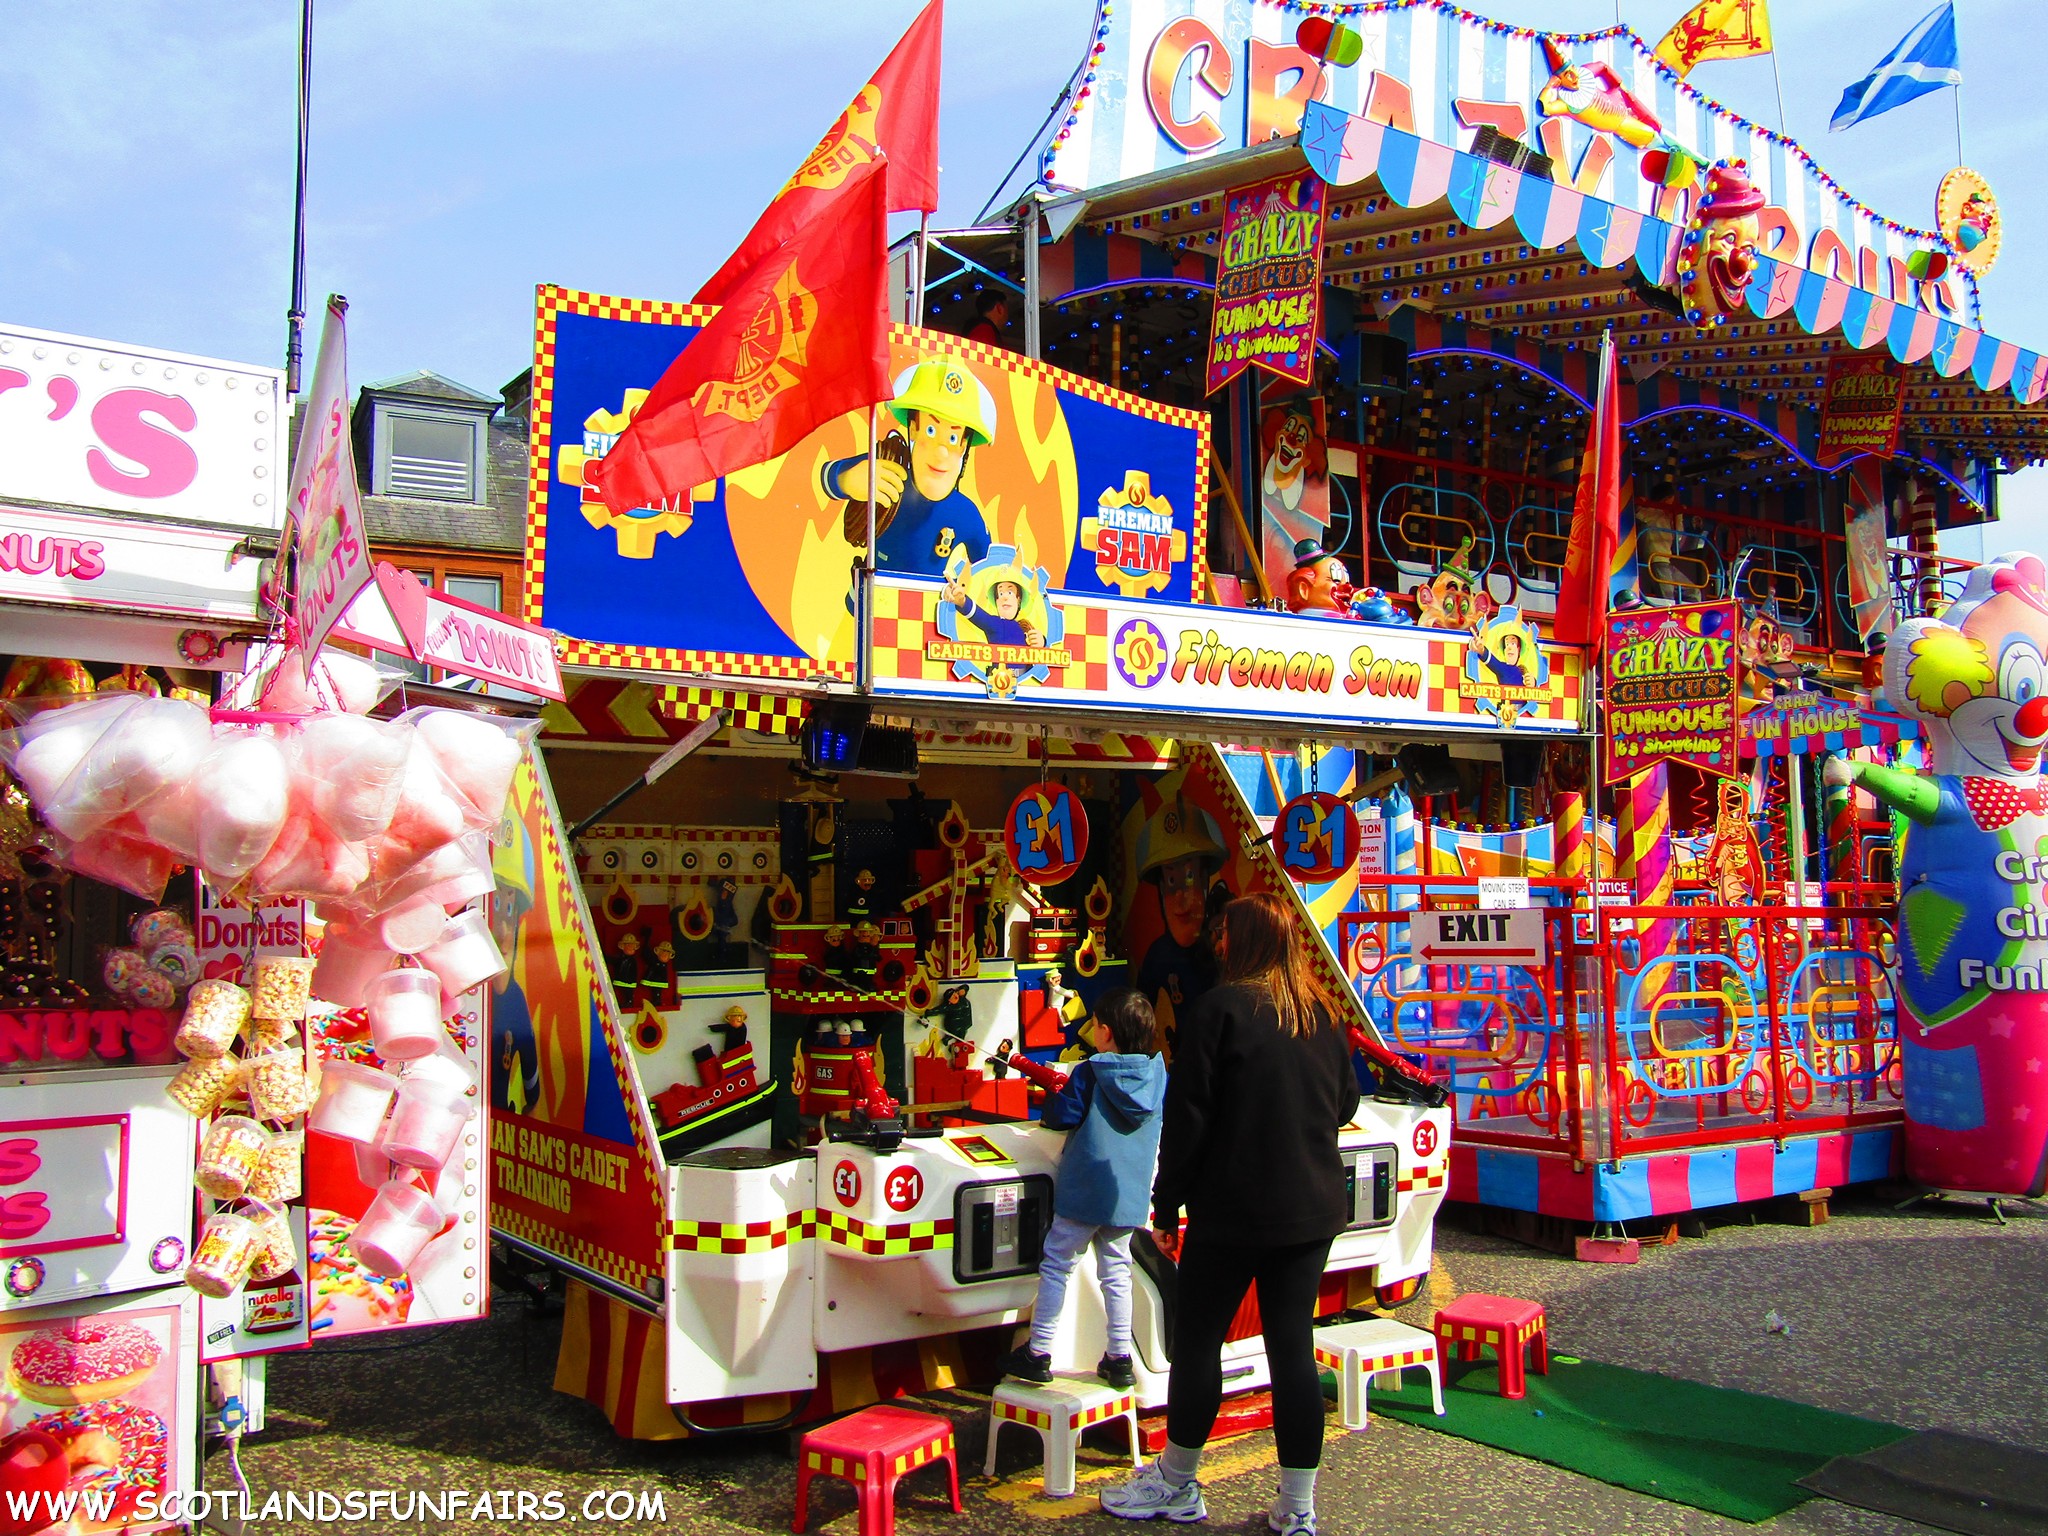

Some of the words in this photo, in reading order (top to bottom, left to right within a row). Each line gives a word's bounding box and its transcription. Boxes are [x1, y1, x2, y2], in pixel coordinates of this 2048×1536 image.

[1223, 210, 1320, 269] CRAZY
[1228, 261, 1308, 296] CIRCUS
[1215, 292, 1311, 337] FUNHOUSE
[1213, 341, 1232, 364] It's
[1236, 331, 1299, 360] Showtime
[1831, 375, 1899, 397] CRAZY
[1825, 414, 1895, 432] FUNHOUSE
[1098, 505, 1173, 535] FIREMAN
[1096, 527, 1172, 574] SAM
[454, 615, 548, 684] DONUTS
[930, 643, 993, 661] CADETS
[997, 646, 1071, 666] TRAINING
[1171, 628, 1335, 694] Fireman
[1343, 644, 1422, 700] Sam
[1610, 637, 1733, 679] CRAZY
[1461, 684, 1502, 698] CADETS
[1504, 687, 1552, 702] TRAINING
[1620, 677, 1720, 702] CIRCUS
[1774, 692, 1820, 710] CRAZY
[1610, 702, 1728, 736] FUNHOUSE
[1739, 717, 1782, 739] FUN
[1789, 708, 1862, 739] HOUSE
[1614, 740, 1639, 758] It's
[1642, 736, 1722, 754] Showtime
[1014, 791, 1076, 871] £1
[1283, 804, 1346, 869] £1
[1481, 883, 1506, 893] MOVING
[1508, 883, 1526, 893] STEPS
[201, 914, 300, 948] Donuts
[1438, 914, 1511, 942] EXIT
[816, 1067, 833, 1079] GAS
[1416, 1127, 1435, 1150] £1
[519, 1127, 566, 1173] SAM'S
[570, 1143, 629, 1193] CADET
[496, 1156, 571, 1214] TRAINING
[836, 1167, 857, 1198] £1
[890, 1174, 919, 1204] £1
[248, 1286, 294, 1306] nutella
